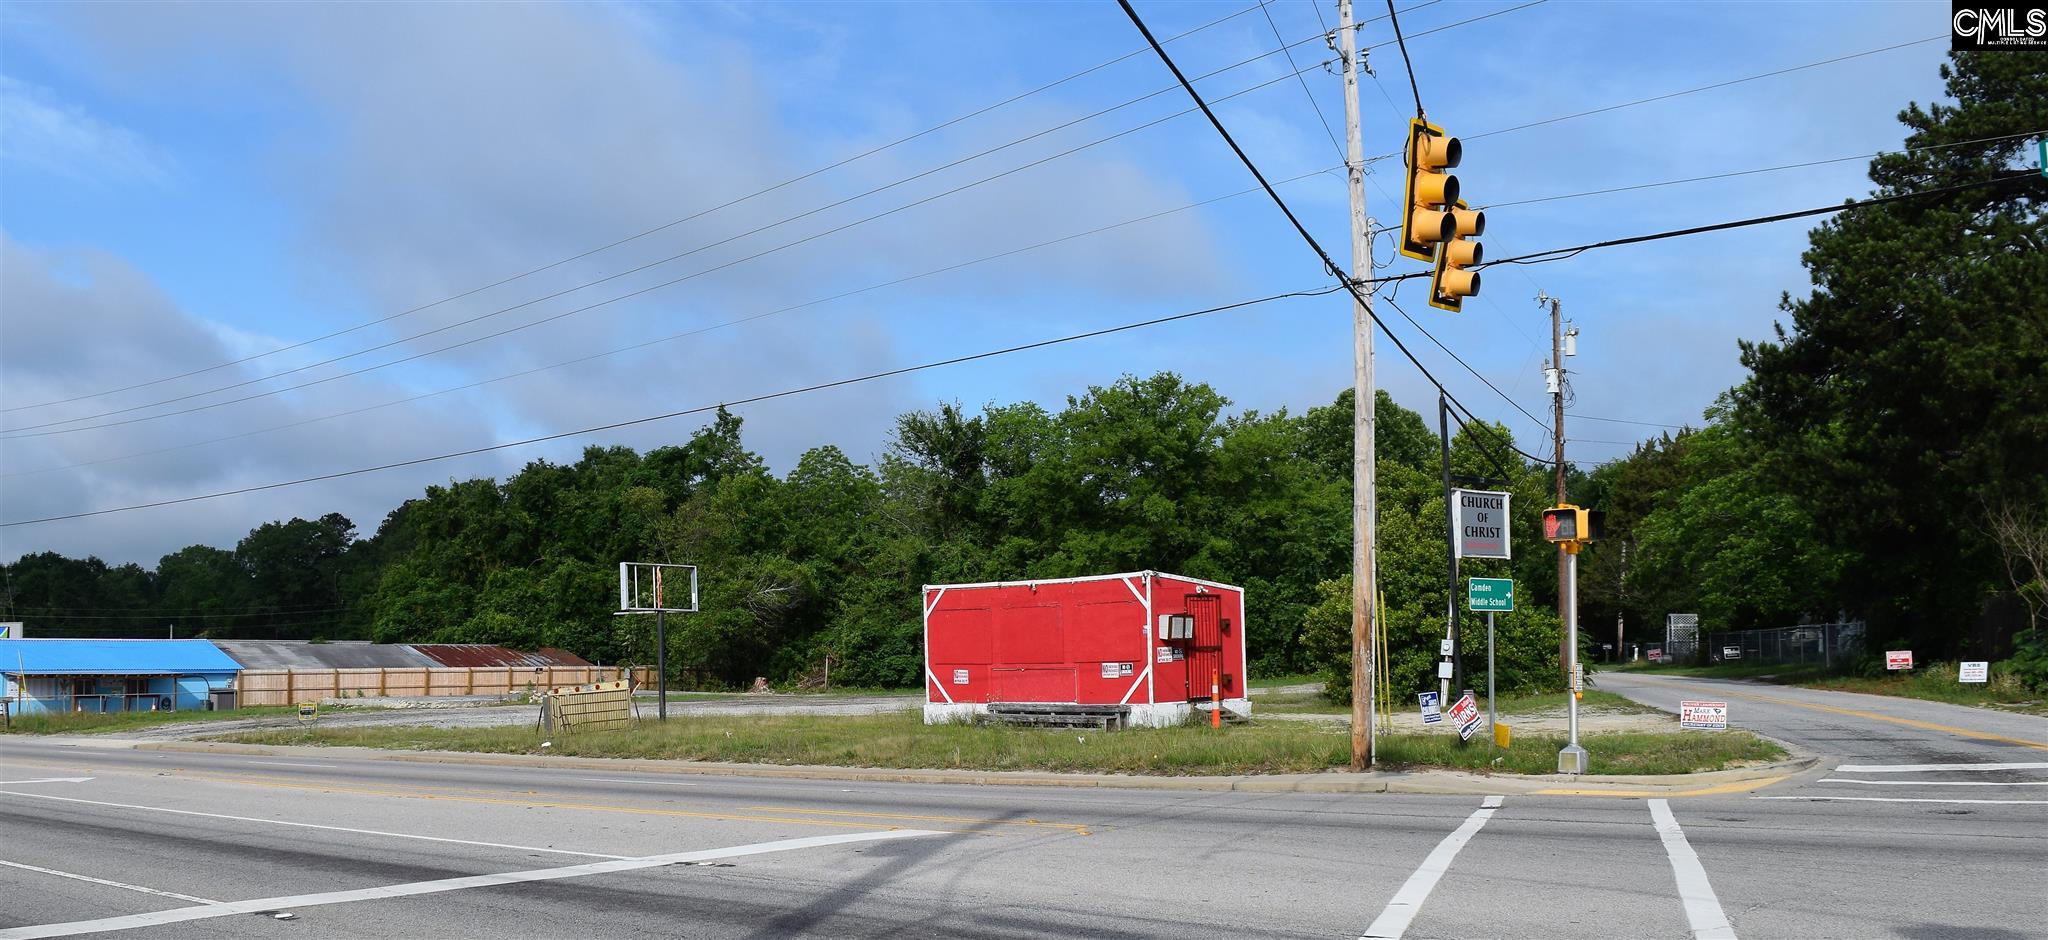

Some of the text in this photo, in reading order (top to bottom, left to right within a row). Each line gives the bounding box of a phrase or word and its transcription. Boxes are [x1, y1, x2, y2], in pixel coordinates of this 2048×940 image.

[1461, 495, 1503, 510] CHURCH
[1477, 512, 1489, 523] OF
[1464, 525, 1501, 538] CHRIST
[1471, 582, 1492, 592] Camden
[1471, 597, 1507, 606] Middle School
[1453, 703, 1476, 728] BURNS
[1682, 709, 1726, 723] HAMMOND
